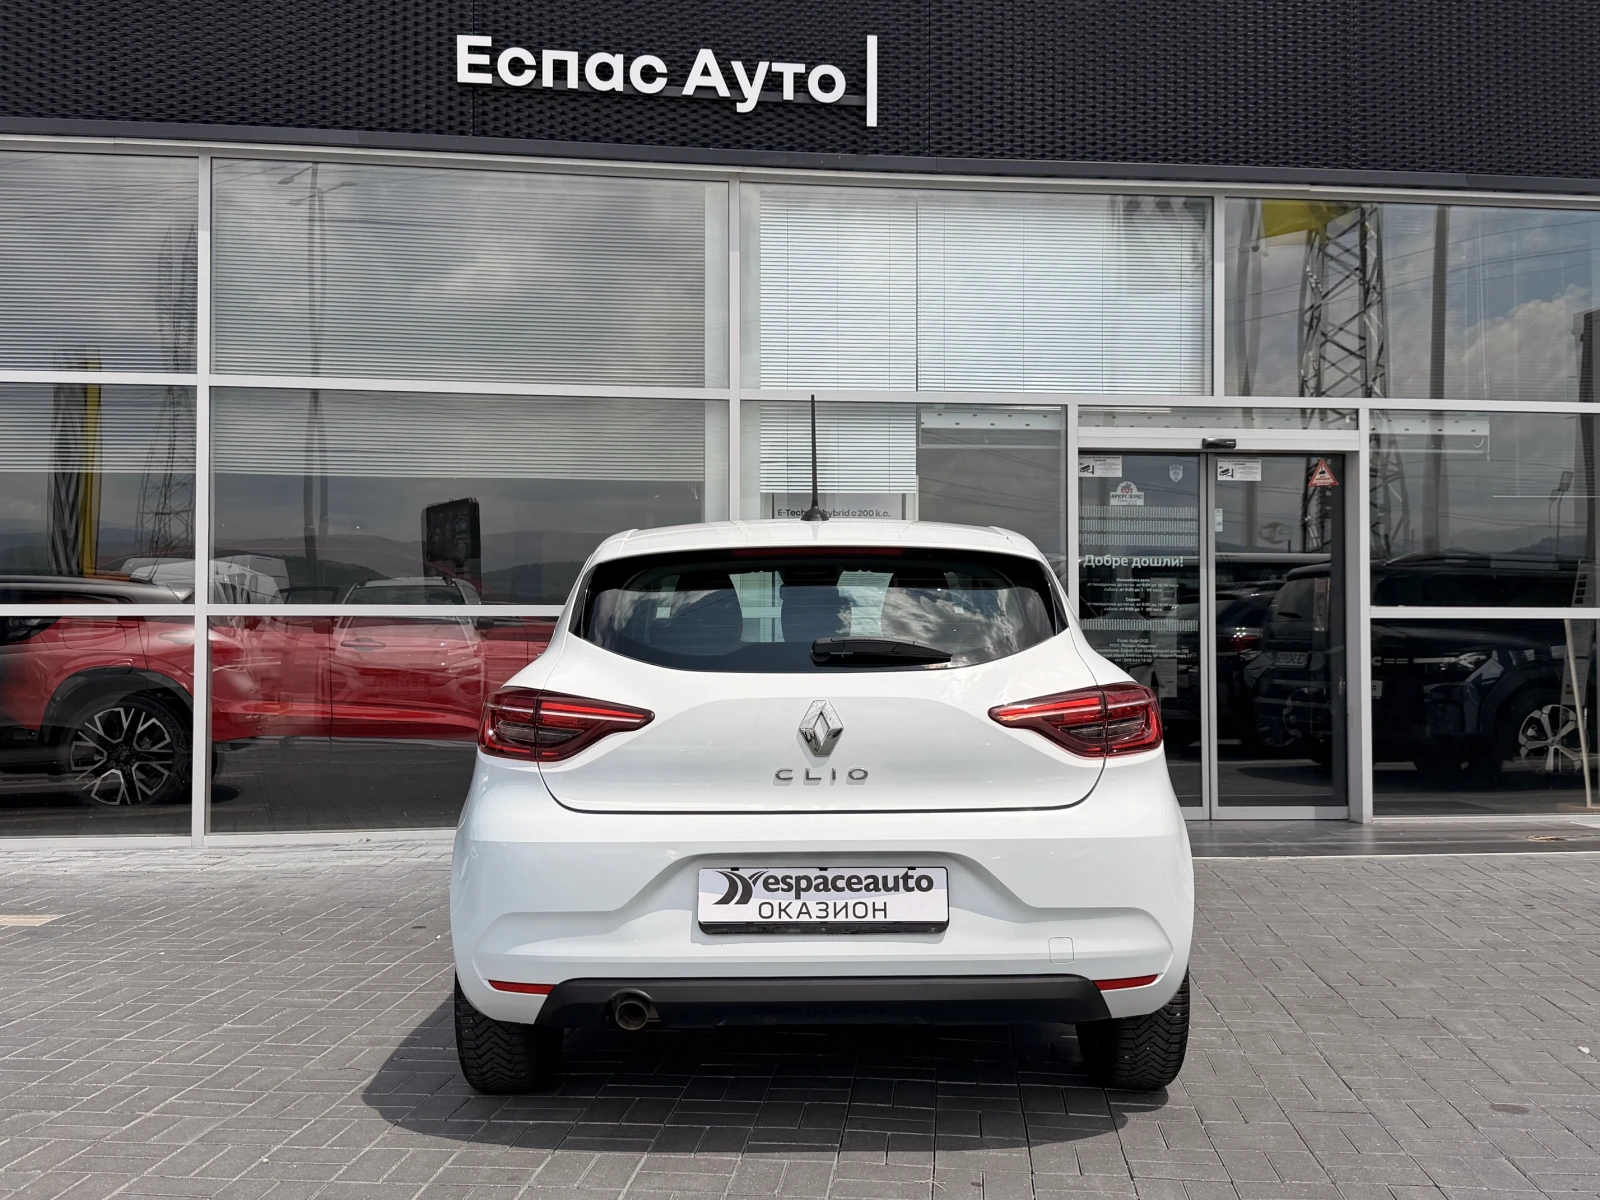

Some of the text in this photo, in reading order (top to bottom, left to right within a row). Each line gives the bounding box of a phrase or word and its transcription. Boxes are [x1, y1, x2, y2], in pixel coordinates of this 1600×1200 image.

[456, 34, 847, 113] Еспас Ауто
[858, 509, 875, 517] 200
[1083, 554, 1183, 569] Добре дошли!
[775, 767, 869, 782] CLIO
[762, 869, 934, 900] espaceauto
[758, 901, 888, 919] ОКАЗИОН
